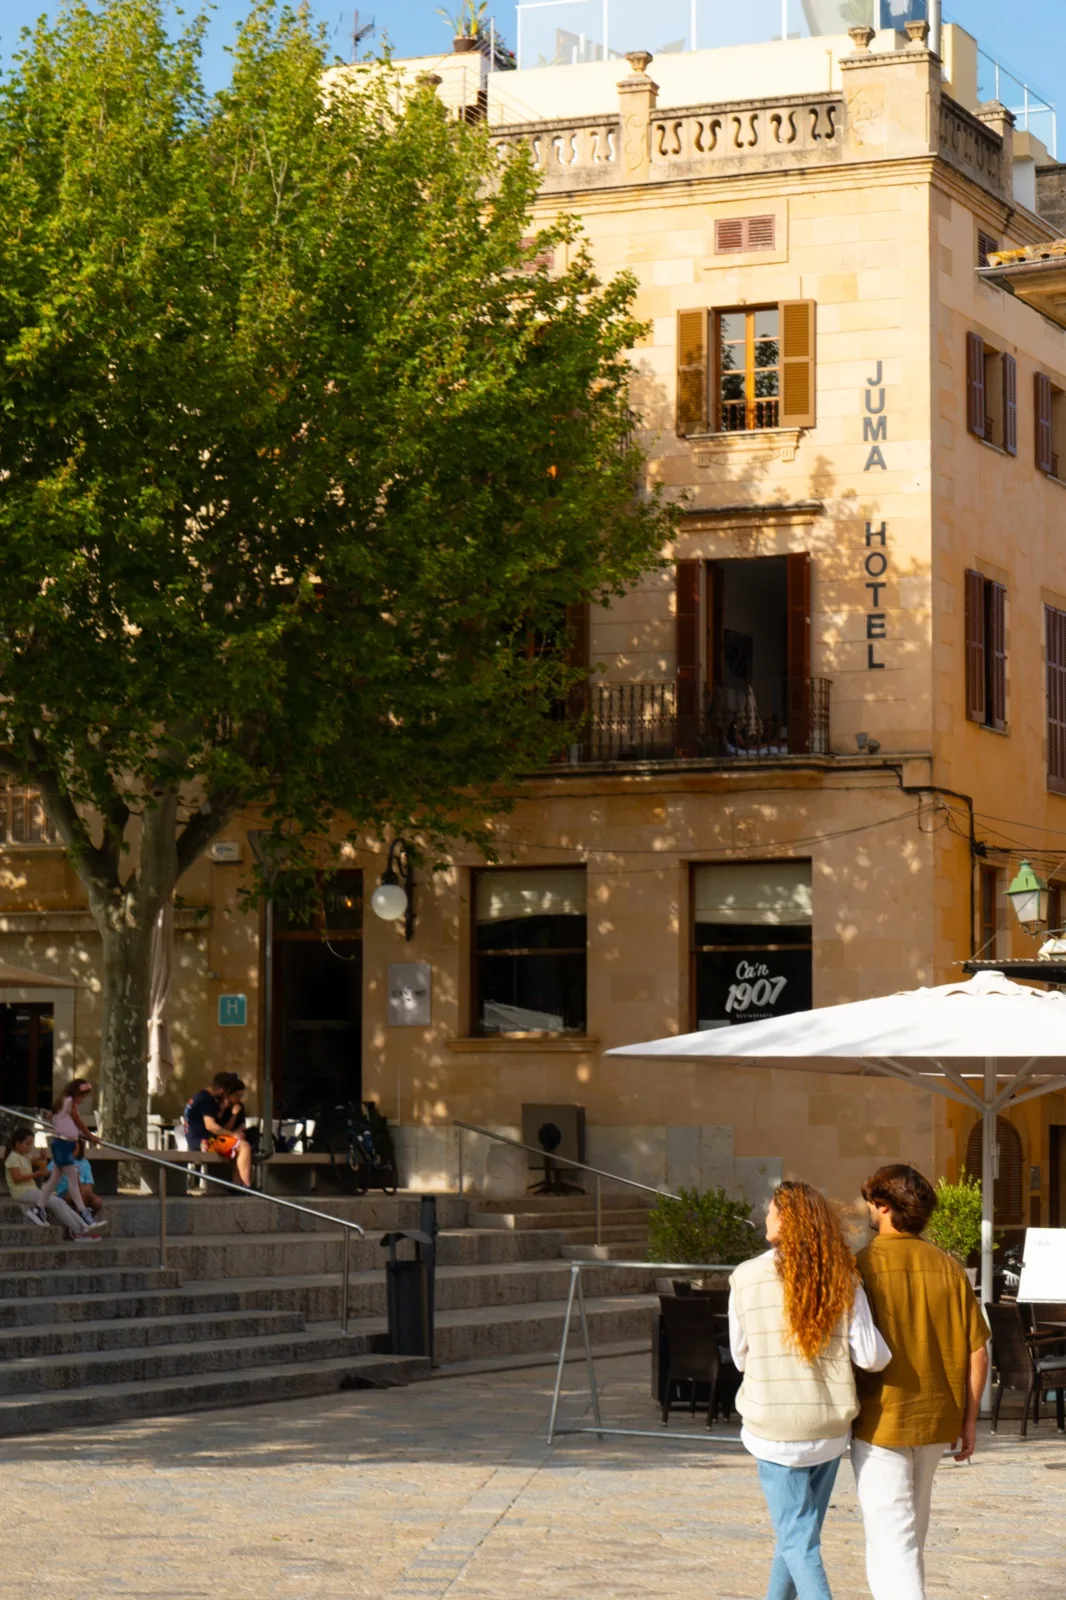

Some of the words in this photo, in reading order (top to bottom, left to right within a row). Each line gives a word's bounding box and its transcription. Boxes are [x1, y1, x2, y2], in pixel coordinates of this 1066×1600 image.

[862, 360, 888, 472] JUMA
[864, 521, 888, 670] HOTEL
[735, 960, 770, 980] Ca'n
[227, 999, 239, 1016] H
[725, 975, 788, 1014] 1907
